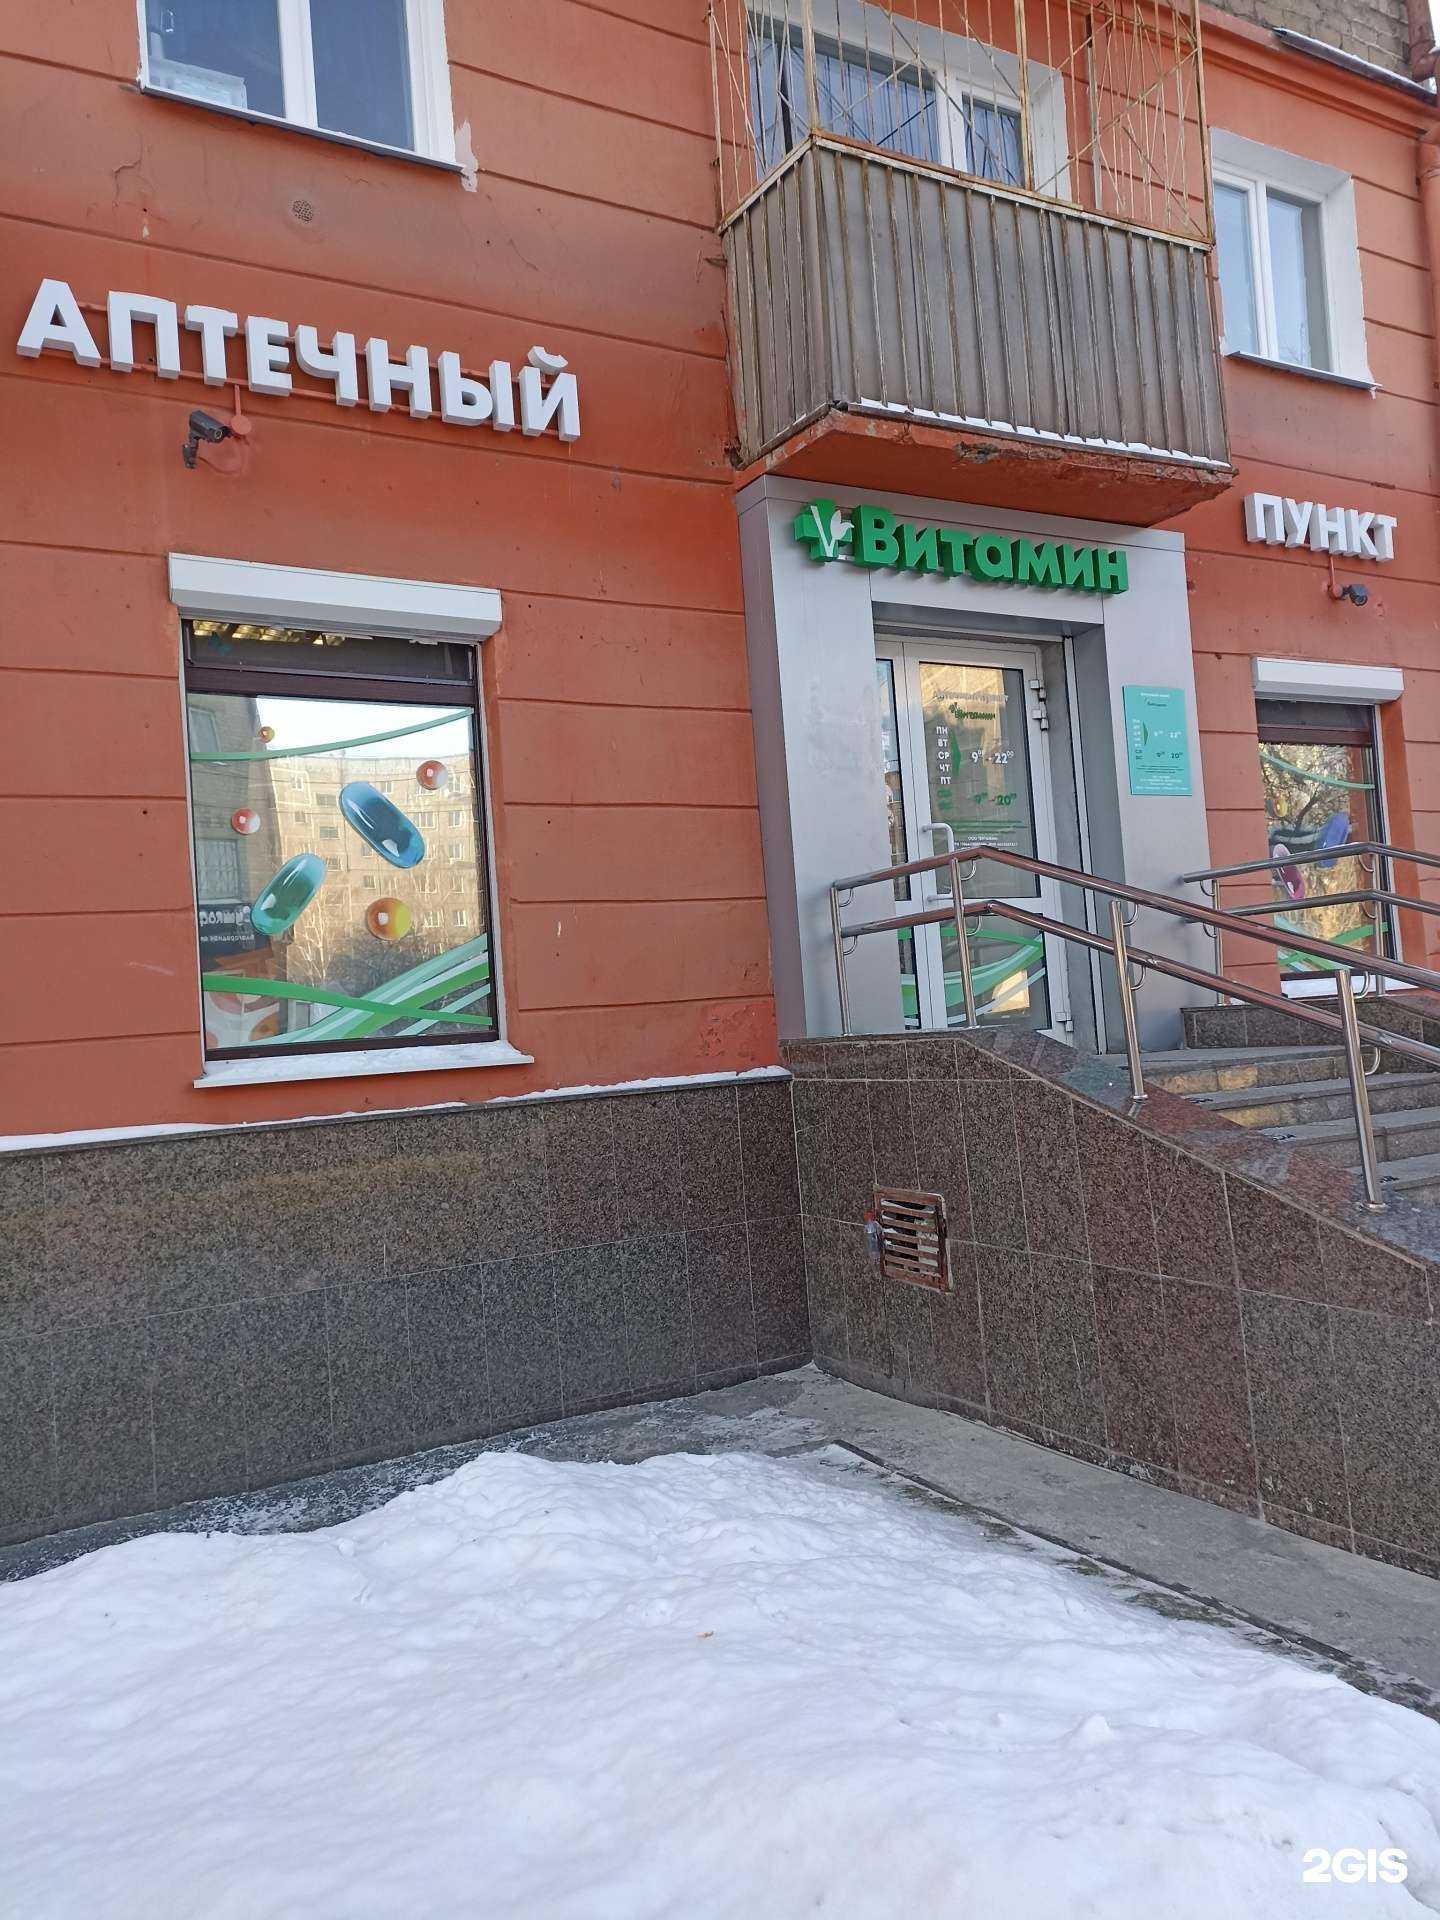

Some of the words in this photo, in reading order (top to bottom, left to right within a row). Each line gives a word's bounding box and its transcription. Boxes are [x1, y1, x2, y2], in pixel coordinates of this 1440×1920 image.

[16, 278, 581, 441] АПТЕЧНЫЙ
[853, 504, 1129, 594] Витамин
[1244, 492, 1398, 562] ПУНКТ
